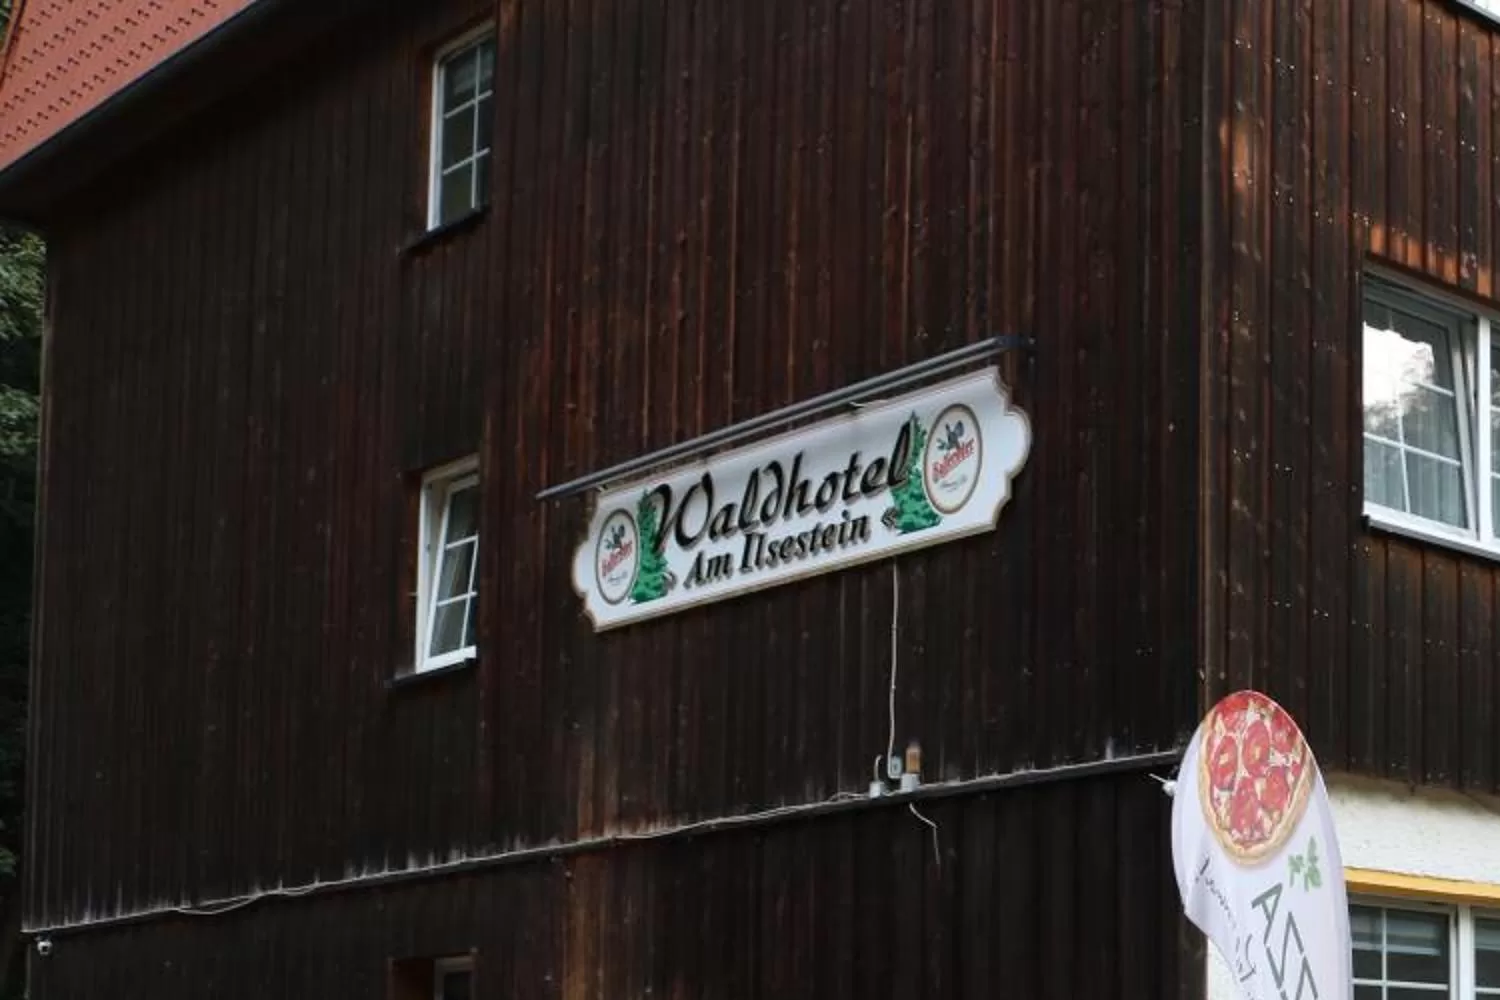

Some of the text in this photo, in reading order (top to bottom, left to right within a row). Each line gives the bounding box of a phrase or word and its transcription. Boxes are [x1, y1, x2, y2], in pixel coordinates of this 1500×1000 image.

[647, 420, 914, 552] Waldhotel
[683, 550, 733, 588] Am
[739, 509, 871, 574] Ilsestein
